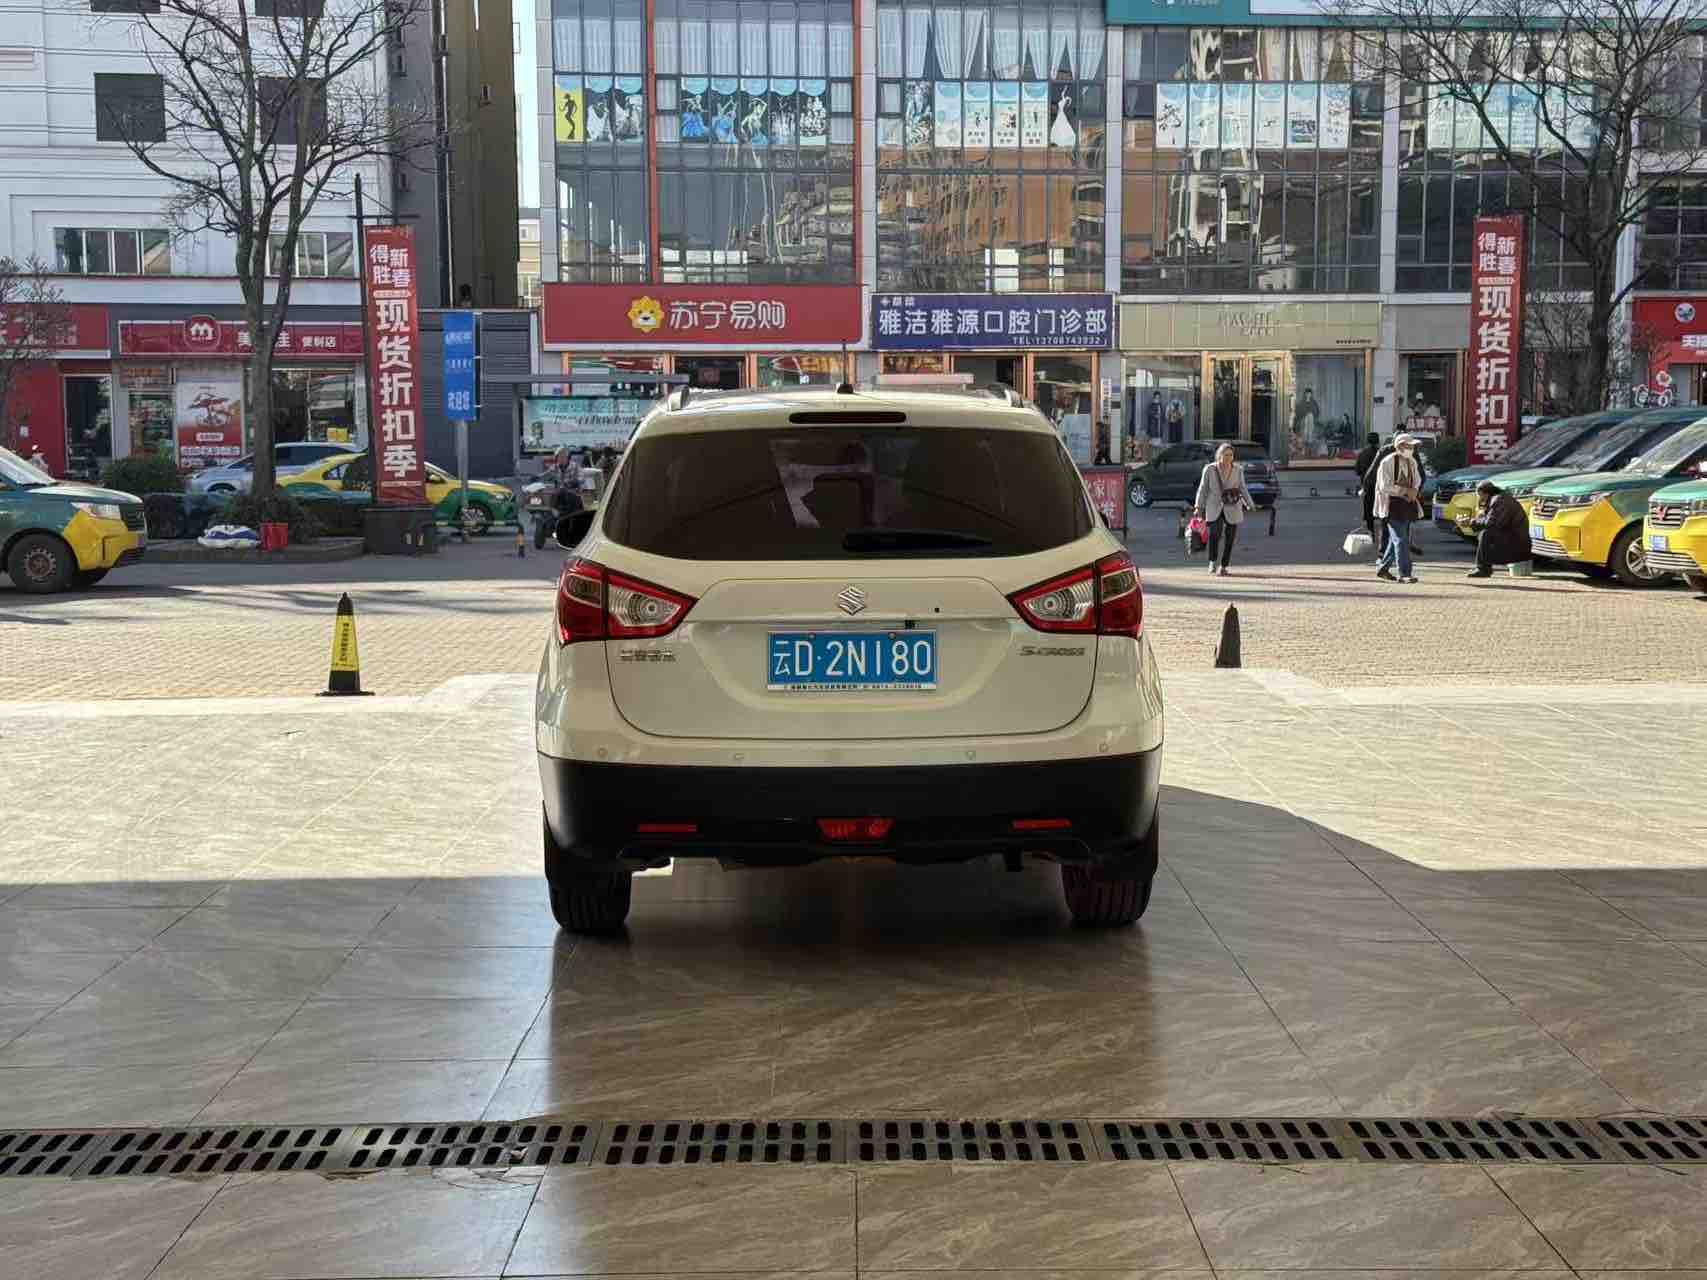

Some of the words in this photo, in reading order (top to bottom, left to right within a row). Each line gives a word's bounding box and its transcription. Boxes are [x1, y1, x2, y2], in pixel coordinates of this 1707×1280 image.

[370, 244, 390, 284] 得胜
[390, 248, 410, 287] 新春
[669, 300, 786, 330] 苏宁易购
[879, 309, 1108, 335] 雅洁雅源口腔门诊部
[238, 331, 290, 348] 美佳
[374, 299, 417, 477] 现货折扣季
[1474, 285, 1512, 463] 现货折扣季
[773, 640, 932, 676] 云D·2N180
